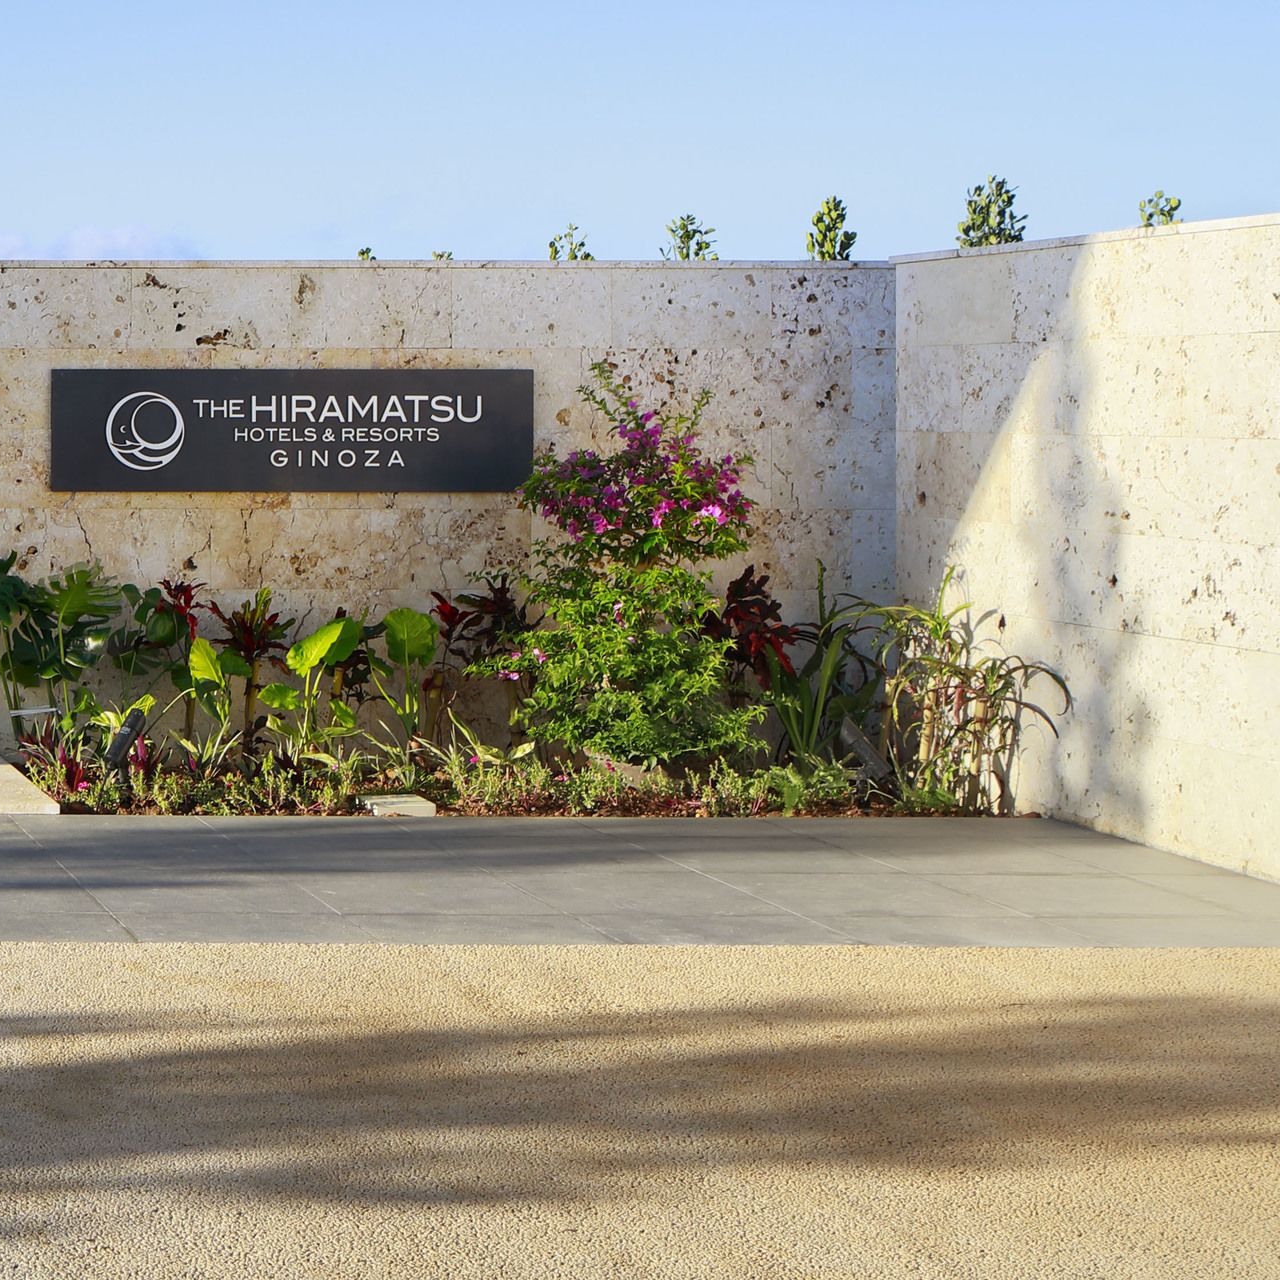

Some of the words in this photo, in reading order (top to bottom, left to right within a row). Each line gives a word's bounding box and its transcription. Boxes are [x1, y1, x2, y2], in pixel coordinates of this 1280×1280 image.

[192, 399, 245, 419] THE
[251, 395, 482, 423] HIRAMATSU
[234, 427, 318, 442] HOTELS
[321, 427, 336, 442] &
[341, 427, 440, 442] RESORTS
[270, 449, 405, 468] GINOZA
